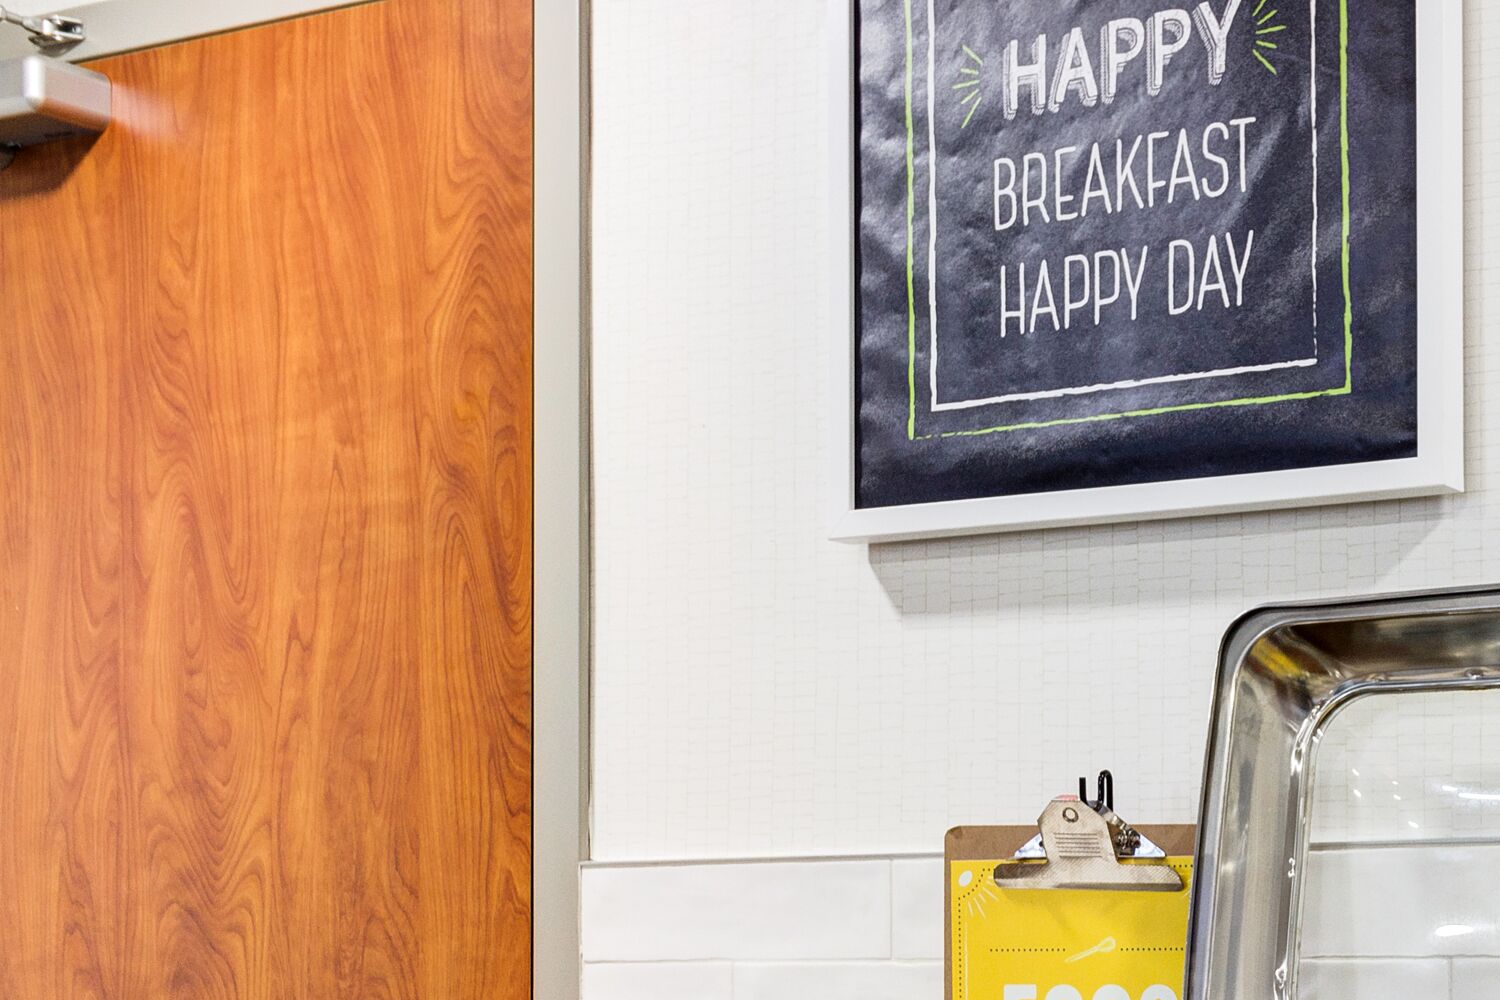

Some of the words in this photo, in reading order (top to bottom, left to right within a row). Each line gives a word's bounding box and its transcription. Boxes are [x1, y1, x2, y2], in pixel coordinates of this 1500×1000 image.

[1003, 0, 1242, 119] HAPPY
[993, 117, 1256, 230] BREAKFAST
[1000, 245, 1149, 338] HAPPY
[1167, 229, 1254, 316] DAY
